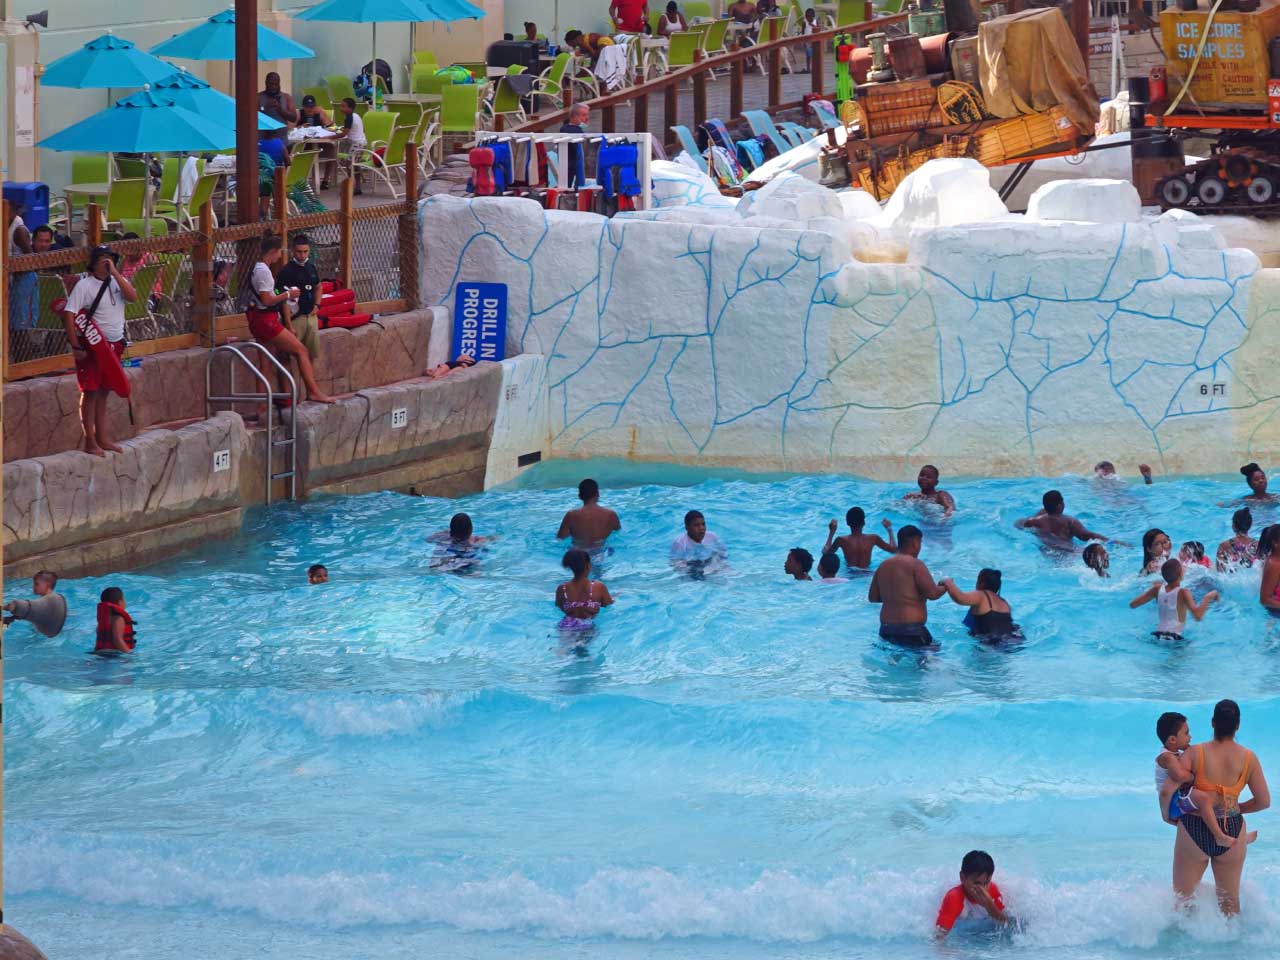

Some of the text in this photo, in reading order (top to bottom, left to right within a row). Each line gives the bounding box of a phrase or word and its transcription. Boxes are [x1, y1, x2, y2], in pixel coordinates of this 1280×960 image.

[1176, 22, 1199, 38] ICE
[1178, 43, 1245, 59] SAMPLES
[460, 288, 480, 360] PROGRES
[480, 298, 498, 358] DRILL IN
[1200, 384, 1225, 395] 6 FT
[394, 411, 406, 424] 5 FT
[215, 453, 228, 468] 4 FT
